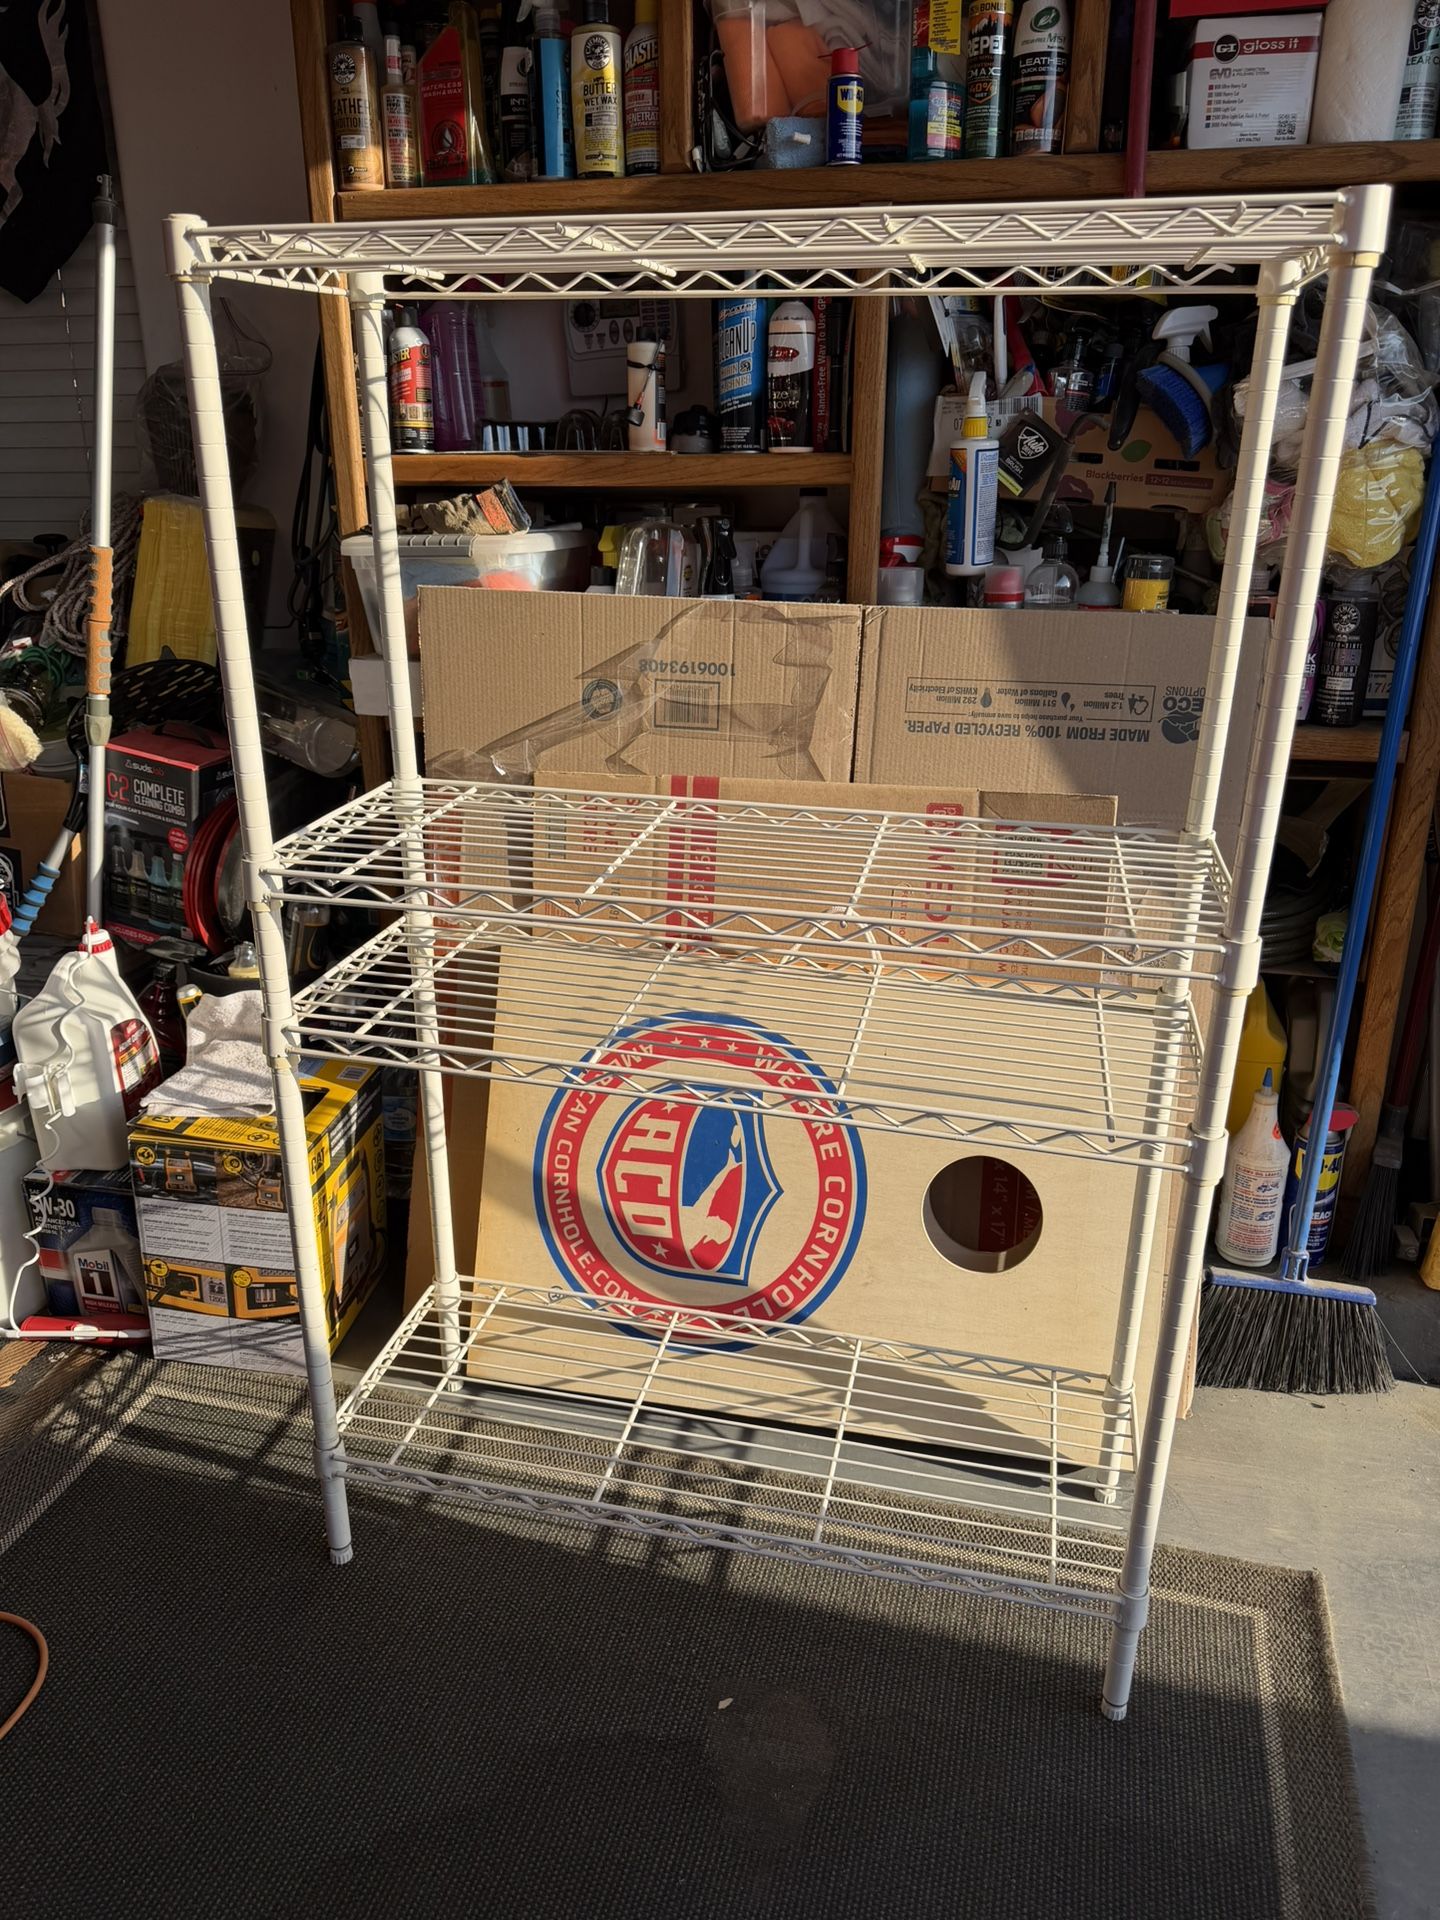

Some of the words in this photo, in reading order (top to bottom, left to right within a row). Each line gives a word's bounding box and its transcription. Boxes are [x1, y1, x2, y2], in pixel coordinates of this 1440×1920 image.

[1216, 43, 1238, 53] GI
[1243, 39, 1286, 54] gloss
[1288, 37, 1299, 49] it
[625, 40, 659, 75] BLASTE
[1019, 56, 1067, 68] LEATHER
[1209, 67, 1232, 79] EVO
[583, 82, 617, 96] BUTTER
[584, 98, 600, 108] WET
[601, 96, 617, 106] WAX
[817, 313, 827, 329] Use
[817, 331, 827, 343] To
[817, 345, 829, 364] Way
[817, 367, 828, 416] Hands-Free
[1018, 431, 1044, 453] Auto
[1086, 469, 1144, 483] Blackberries
[638, 658, 737, 678] 1006193408
[908, 683, 945, 694] Electricity
[955, 685, 978, 694] KWHS
[997, 688, 1019, 697] Water
[1020, 689, 1028, 697] of
[1029, 688, 1058, 698] Gallons
[1104, 691, 1124, 700] Trees
[1165, 686, 1207, 698] OPTIONS
[936, 695, 961, 704] Million
[1015, 698, 1040, 707] Million
[1042, 699, 1057, 707] 511
[1083, 700, 1110, 710] Million
[1112, 701, 1123, 710] 1.2
[1162, 697, 1204, 712] ECO
[904, 720, 951, 736] PAPER.
[955, 722, 1021, 738] RECYCLED
[1025, 724, 1062, 740] 100%
[1067, 726, 1106, 741] FROM
[1110, 728, 1150, 743] MADE
[107, 771, 130, 804] C2
[133, 778, 185, 807] COMPLETE
[311, 1147, 326, 1176] CAT
[30, 1195, 76, 1219] 5W-30
[78, 1257, 110, 1271] Mobil
[89, 1271, 104, 1295] 1
